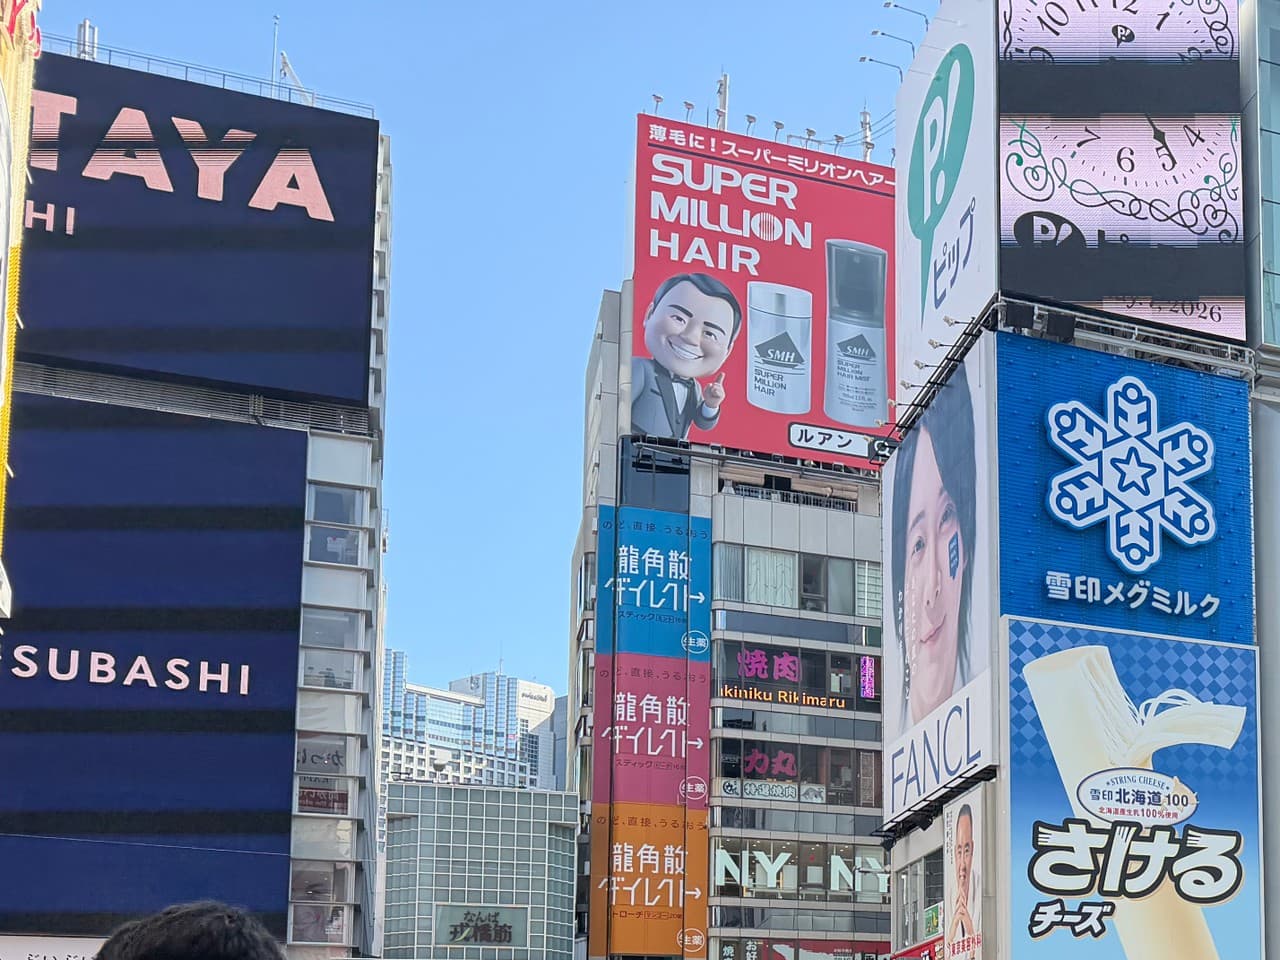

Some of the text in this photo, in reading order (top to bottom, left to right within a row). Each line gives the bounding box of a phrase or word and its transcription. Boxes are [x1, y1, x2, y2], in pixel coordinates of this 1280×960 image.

[1116, 146, 1136, 173] 6
[651, 153, 798, 210] SUPER
[650, 192, 812, 249] MILLION
[649, 229, 760, 276] HAIR
[933, 196, 976, 310] ピップ
[767, 348, 796, 363] SMH
[754, 369, 784, 382] SUPER
[754, 377, 787, 391] MILLION
[754, 386, 776, 396] HAIR
[797, 429, 852, 448] ルアン
[619, 545, 692, 581] 龍角散
[1045, 570, 1221, 618] 雪印メグミルク
[616, 692, 690, 727] 龍角散
[891, 697, 981, 813] FANCL
[1110, 775, 1165, 789] STRING CHEESE
[612, 843, 688, 876] 龍角散
[1029, 820, 1242, 902] さける
[463, 911, 500, 924] なんば
[1028, 899, 1114, 938] チーズ
